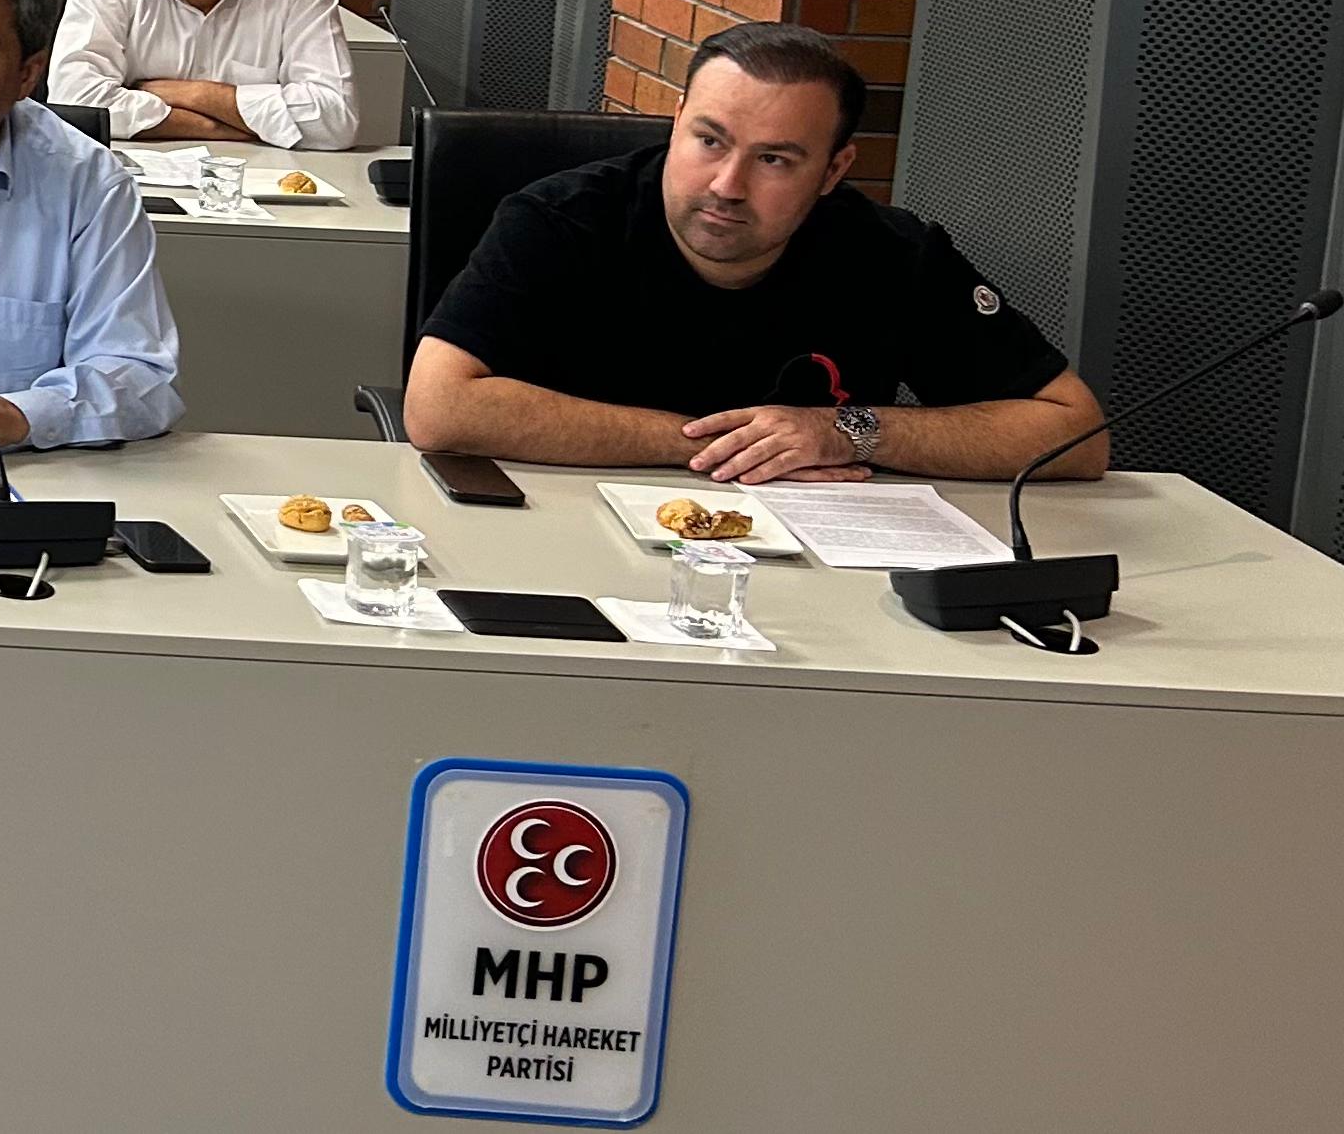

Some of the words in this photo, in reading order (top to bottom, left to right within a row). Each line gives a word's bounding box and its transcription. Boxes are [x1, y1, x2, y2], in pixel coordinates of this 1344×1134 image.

[472, 947, 609, 1003] MHP
[424, 1013, 538, 1047] MİLLİYETÇİ
[542, 1026, 641, 1052] HAREKET
[486, 1055, 574, 1082] PARTİSİ
